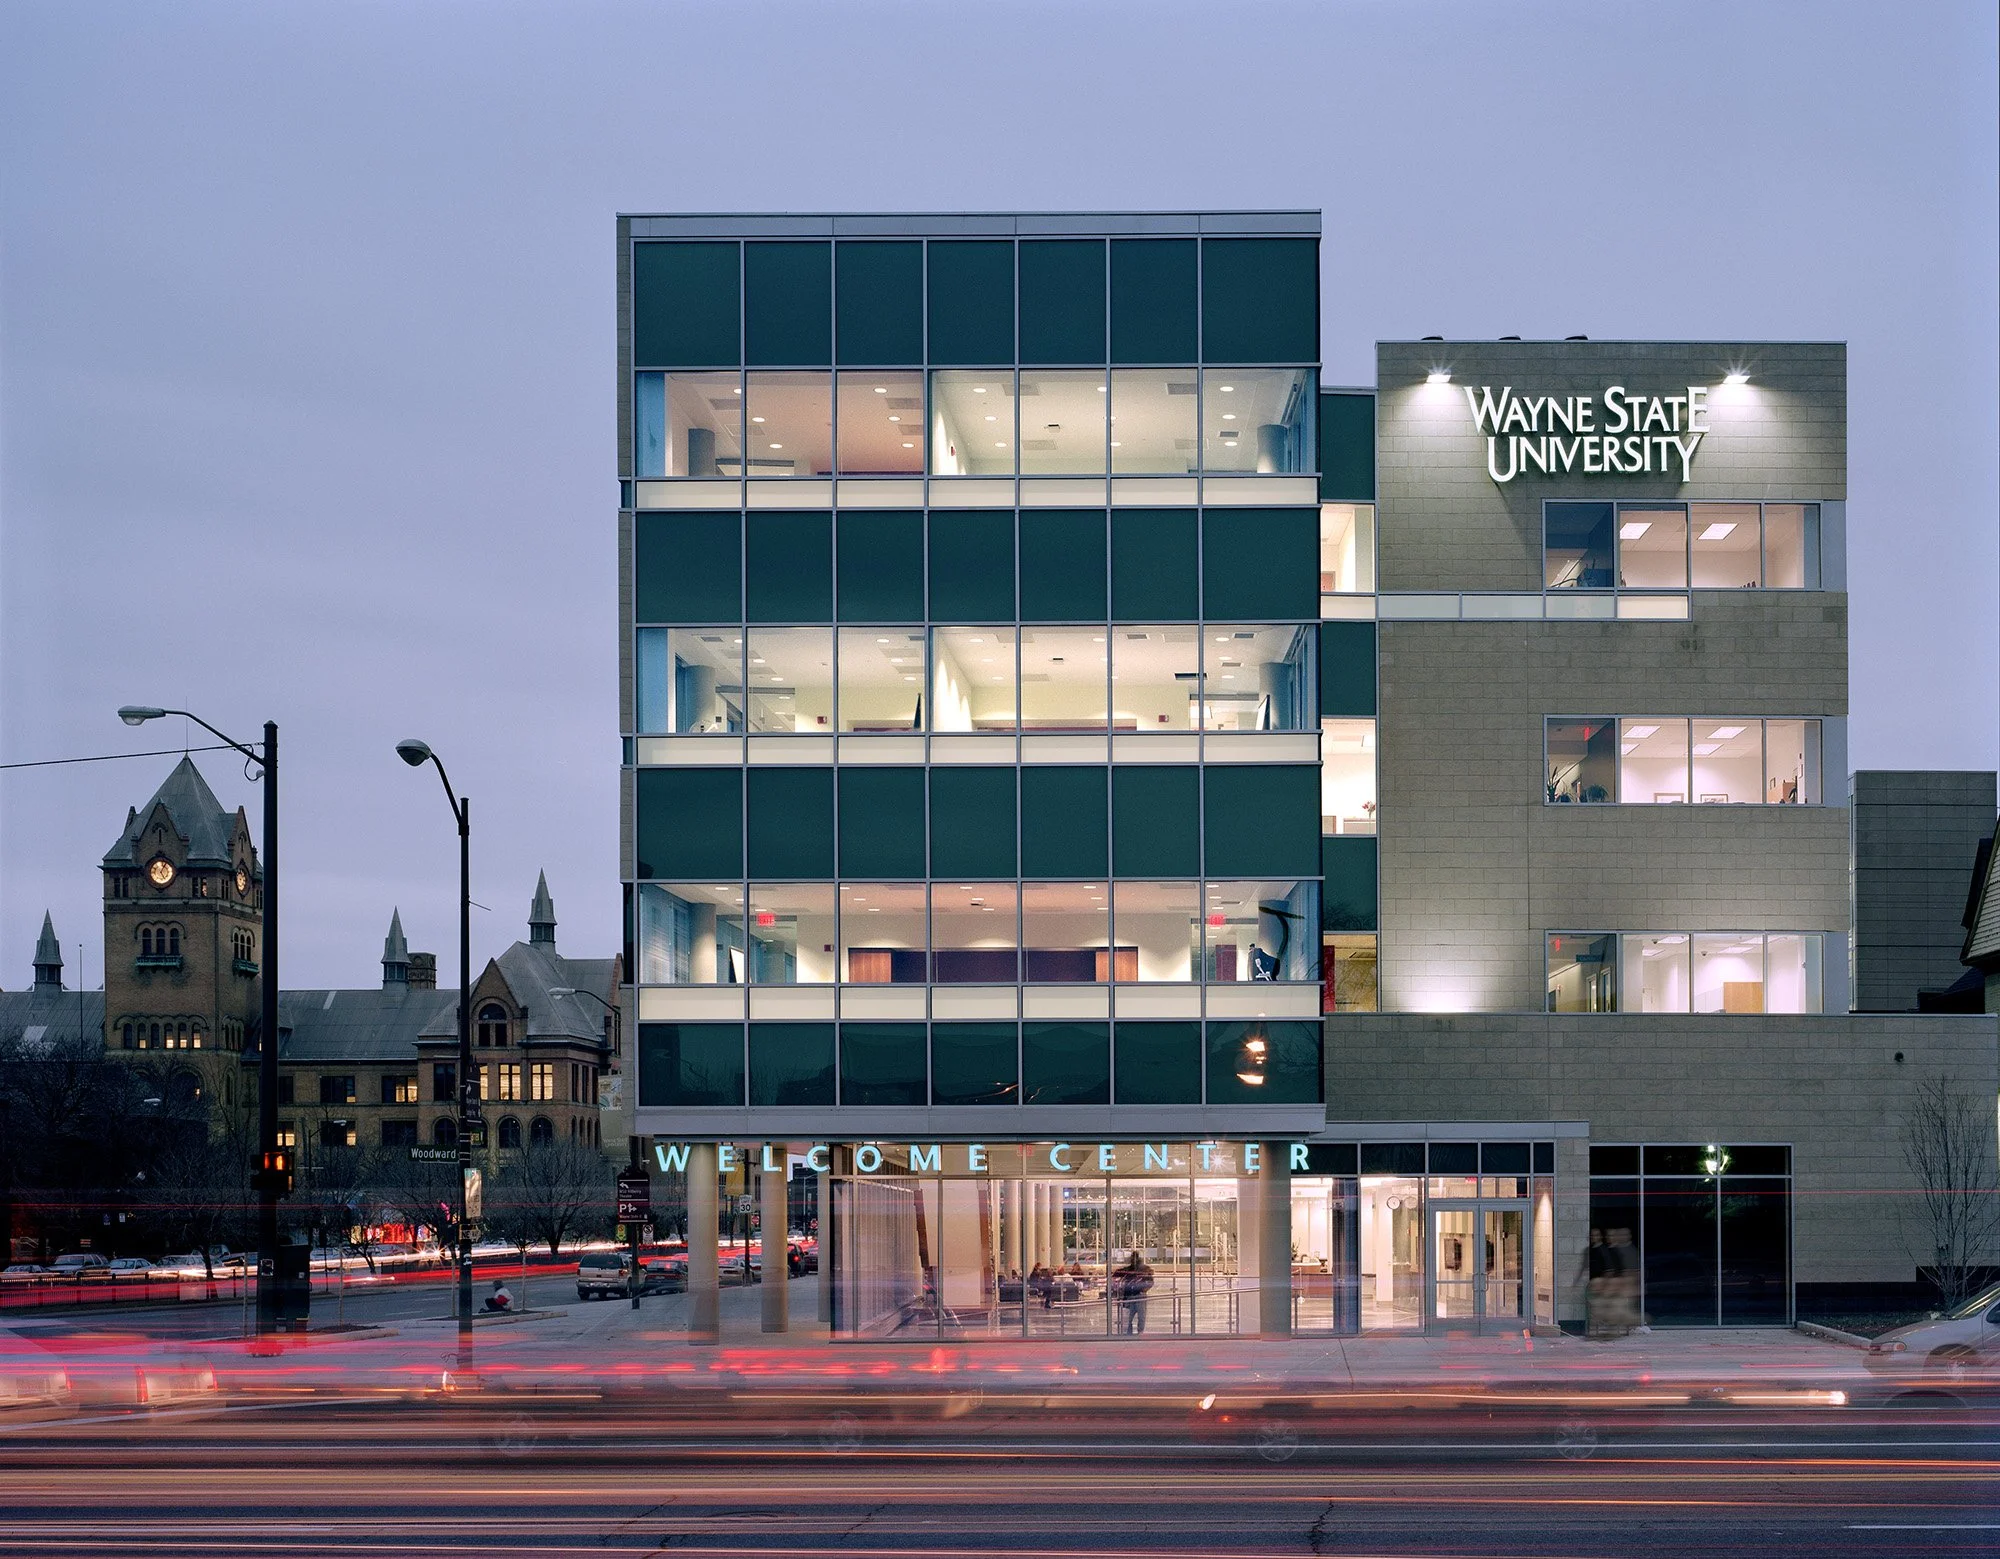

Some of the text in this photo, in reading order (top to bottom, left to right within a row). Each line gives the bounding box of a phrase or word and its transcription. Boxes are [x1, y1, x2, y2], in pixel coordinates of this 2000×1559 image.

[1463, 386, 1711, 434] WAYNE STATE
[1487, 436, 1704, 483] UNIVERSITY
[411, 1147, 457, 1159] Woodward
[655, 1145, 987, 1172] WELCOME
[1049, 1143, 1310, 1171] CENTER
[619, 1203, 627, 1213] P
[740, 1204, 751, 1212] 30
